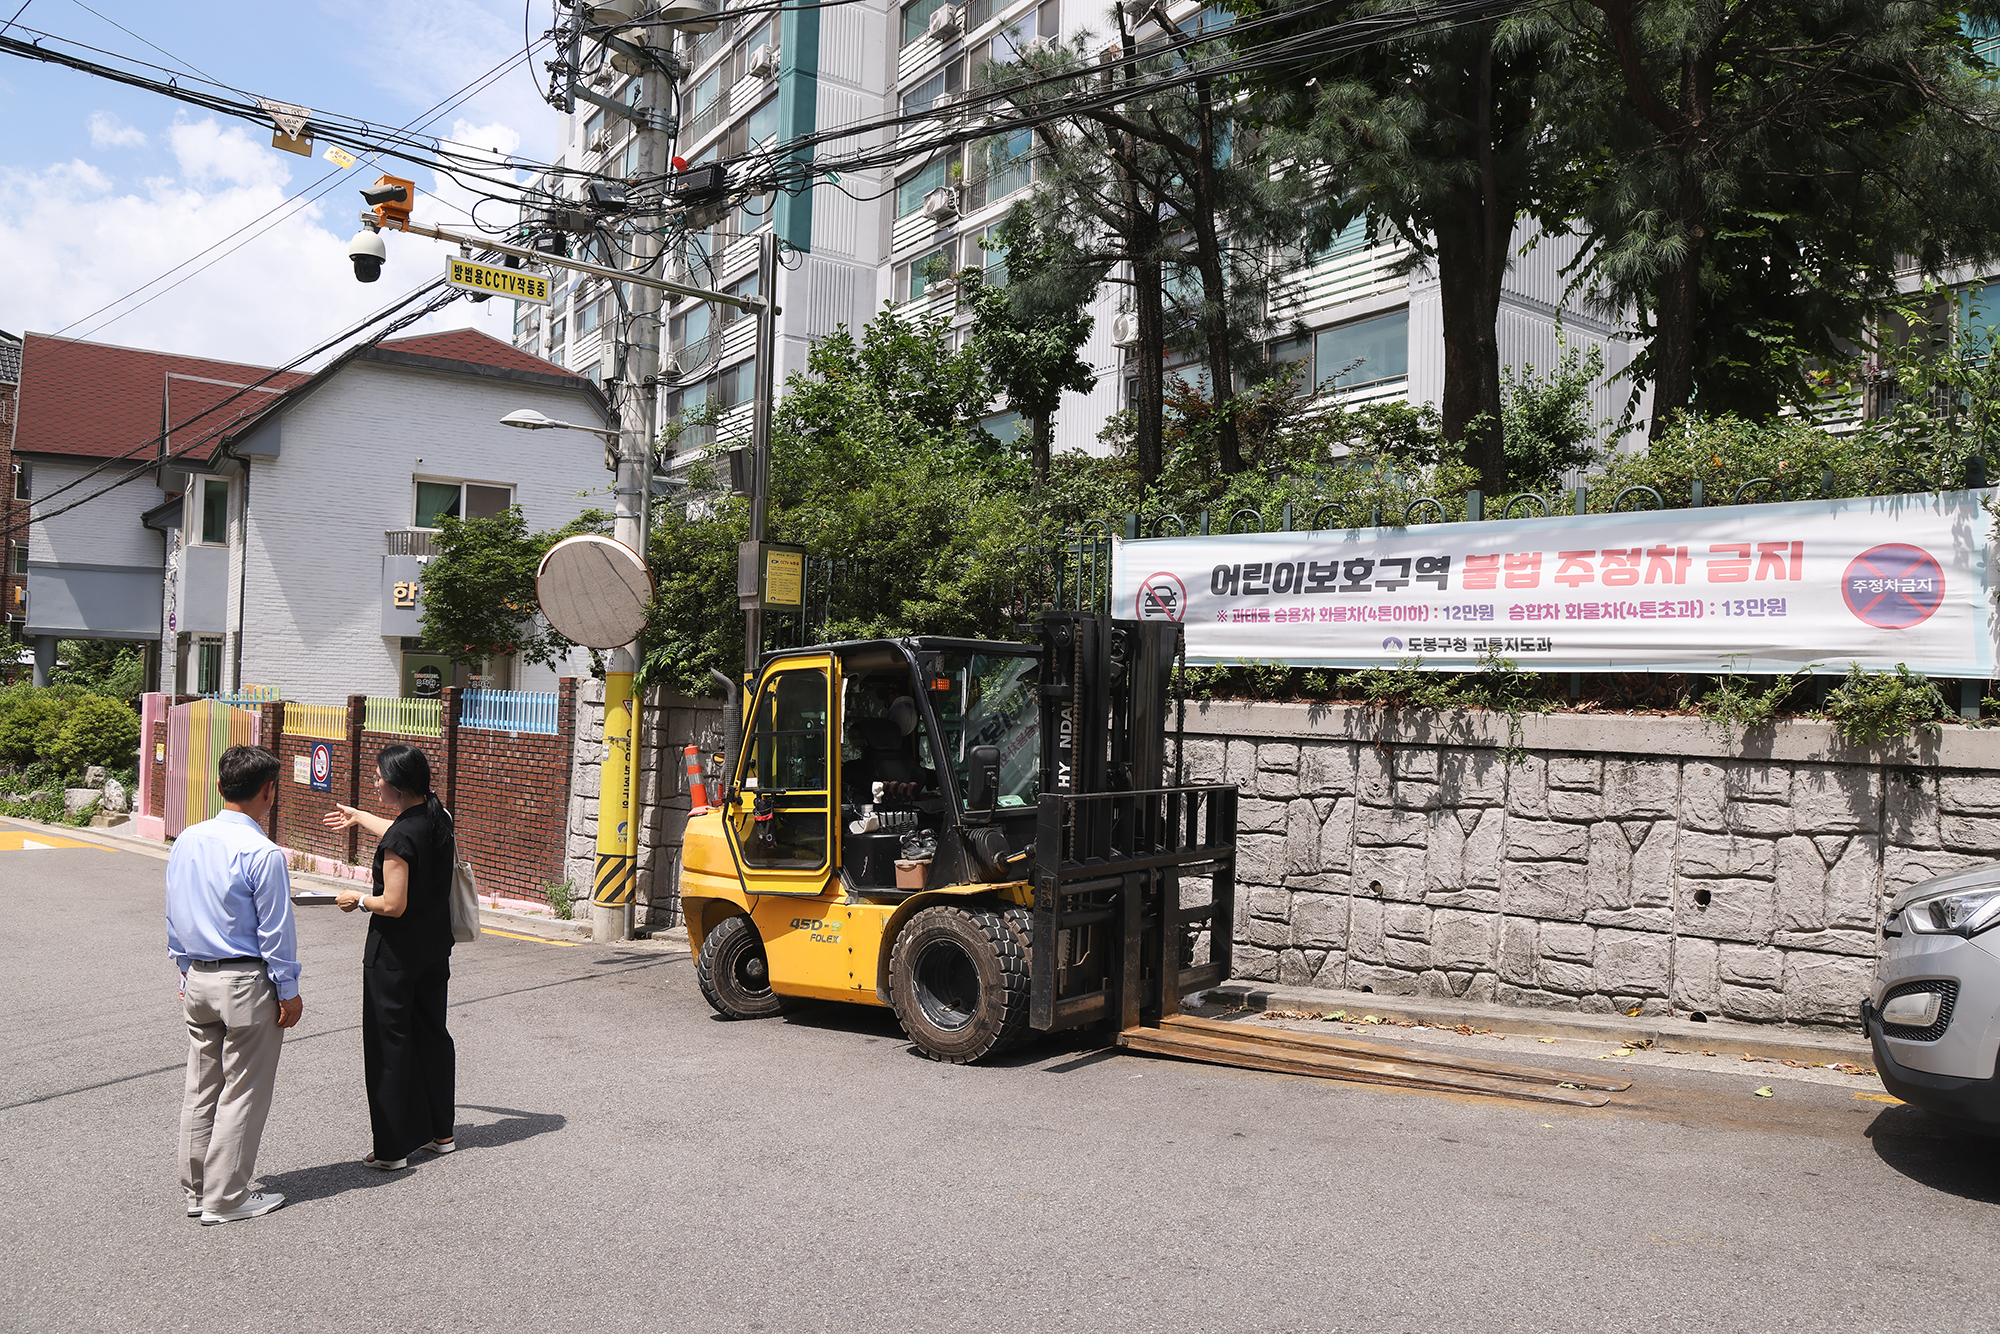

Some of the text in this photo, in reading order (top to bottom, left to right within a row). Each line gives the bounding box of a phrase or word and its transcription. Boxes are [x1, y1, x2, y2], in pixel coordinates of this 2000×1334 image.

[454, 264, 545, 298] 방범용CCTV작동중
[1211, 540, 1804, 596] 어린이보호구역 불법 주정차 금지
[1853, 577, 1933, 594] 주정차금지
[1232, 608, 1270, 623] 과태료
[1274, 606, 1316, 623] 승용차
[1319, 604, 1429, 623] 화물차(4톤이하)
[1443, 603, 1494, 621] 12만원
[1508, 603, 1561, 621] 승합차
[1565, 599, 1704, 620] 화물차(4톤초과)
[1721, 598, 1787, 617] 13만원
[1408, 637, 1553, 653] 도봉구청 교통지도과
